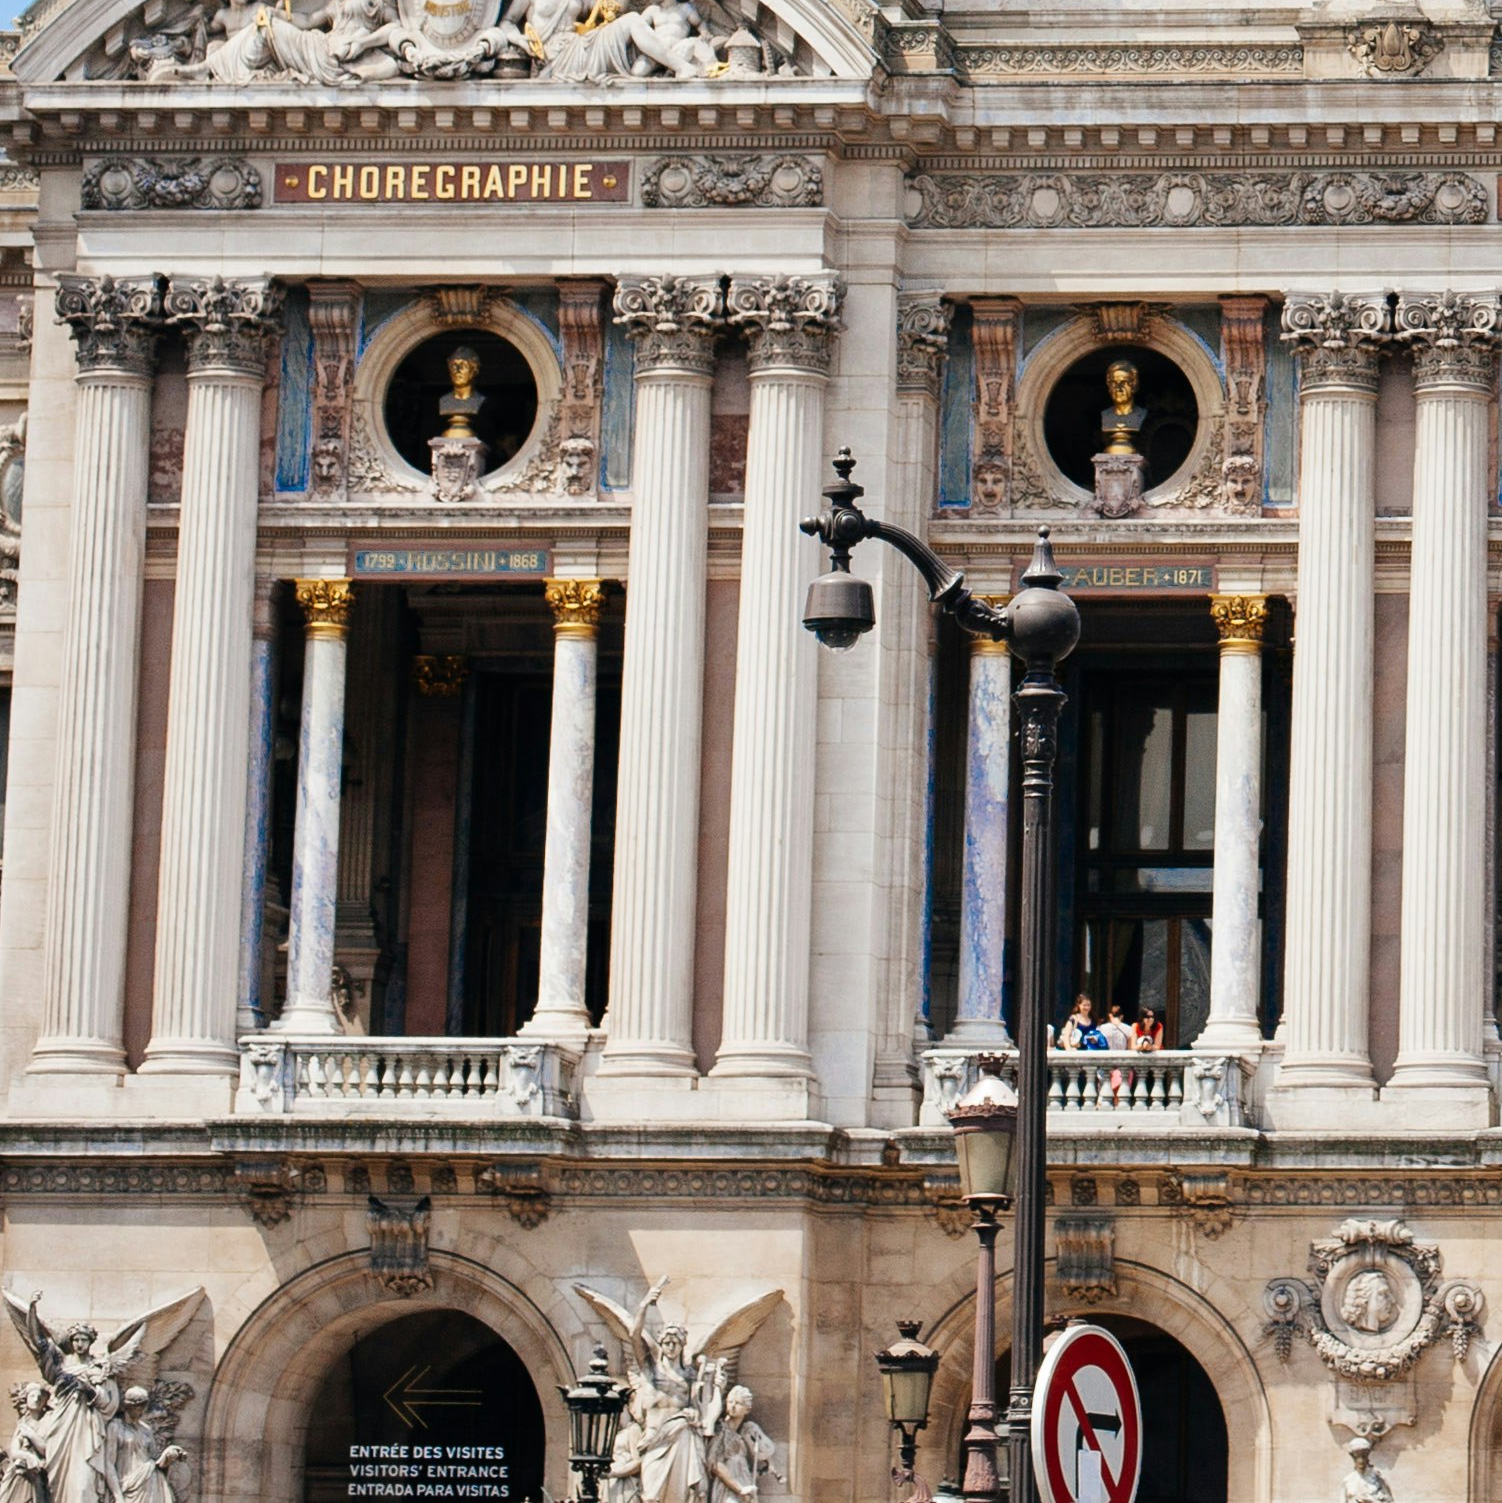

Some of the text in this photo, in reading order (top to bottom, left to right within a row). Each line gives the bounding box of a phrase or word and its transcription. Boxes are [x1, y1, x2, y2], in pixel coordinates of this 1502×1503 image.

[307, 164, 593, 200] CHOREGRAPHIE
[364, 554, 395, 568] 1799
[510, 553, 538, 568] 1868
[1073, 567, 1201, 586] AUBER 1871
[350, 1442, 504, 1459] ENTRÉE DES VISITES
[427, 1466, 509, 1478] ENTRANCE
[347, 1483, 509, 1497] ENTRADA PARA VISITAS
